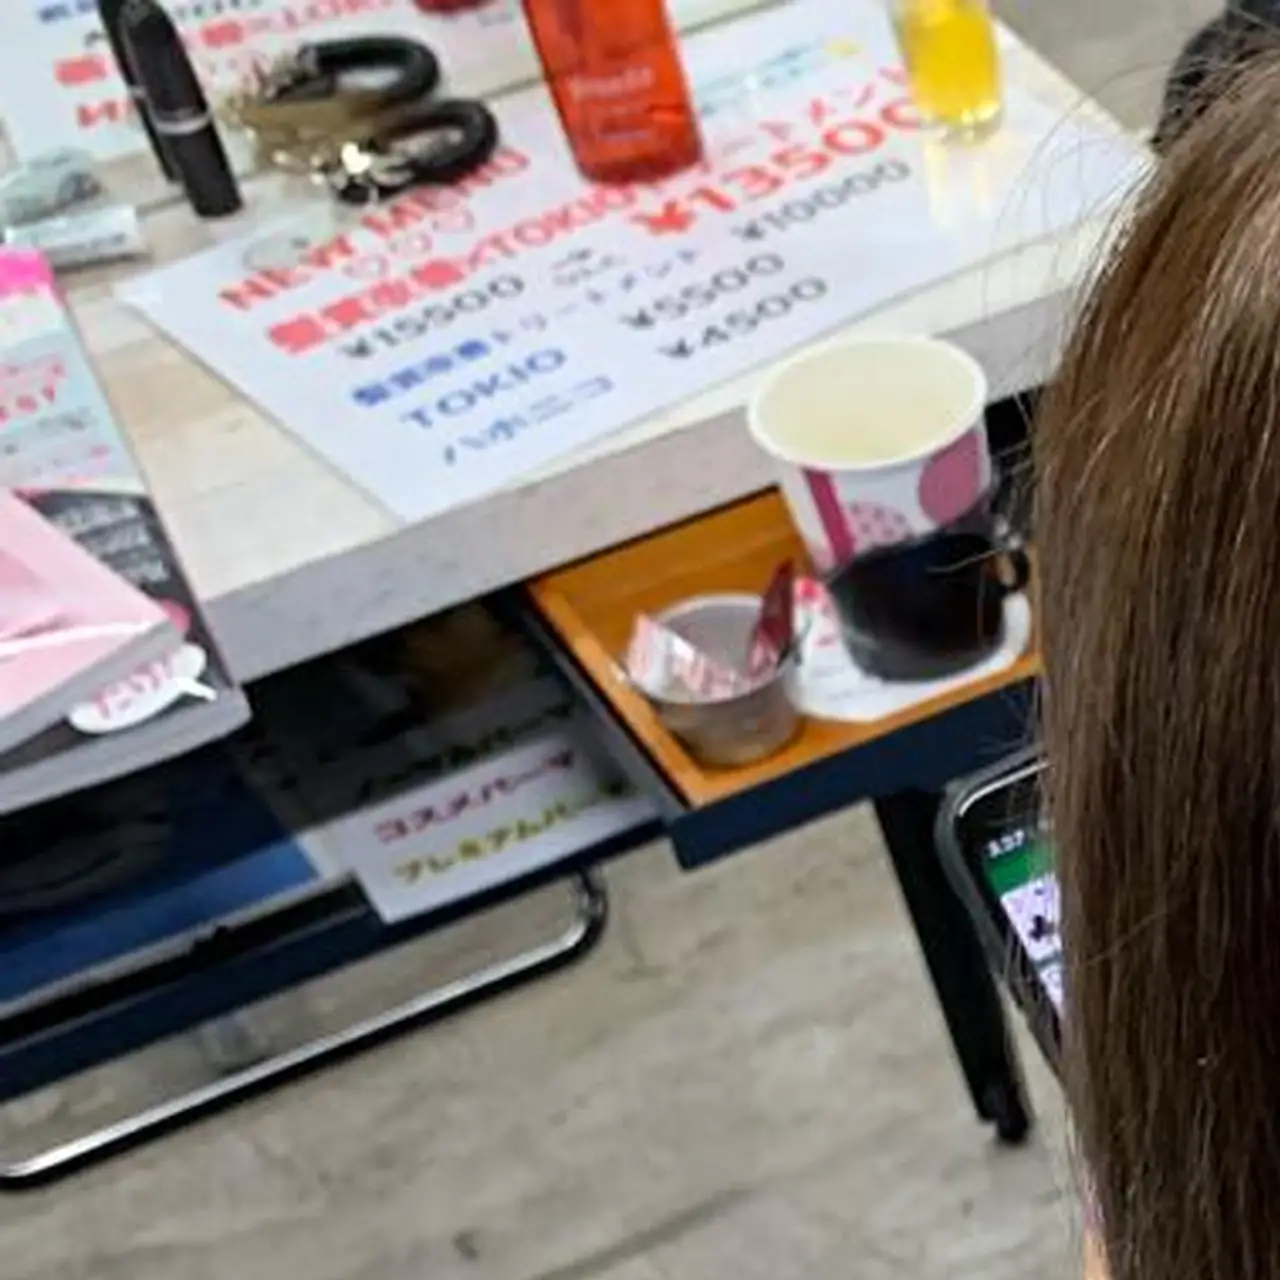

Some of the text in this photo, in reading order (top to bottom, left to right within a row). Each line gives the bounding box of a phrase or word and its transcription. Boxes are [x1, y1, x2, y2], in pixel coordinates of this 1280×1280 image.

[731, 159, 910, 241] ¥10000
[219, 234, 352, 311] NEW
[339, 274, 524, 357] ¥15500
[400, 348, 566, 428] TOKIO
[620, 252, 785, 328] ¥5500
[659, 276, 826, 358] ¥4500
